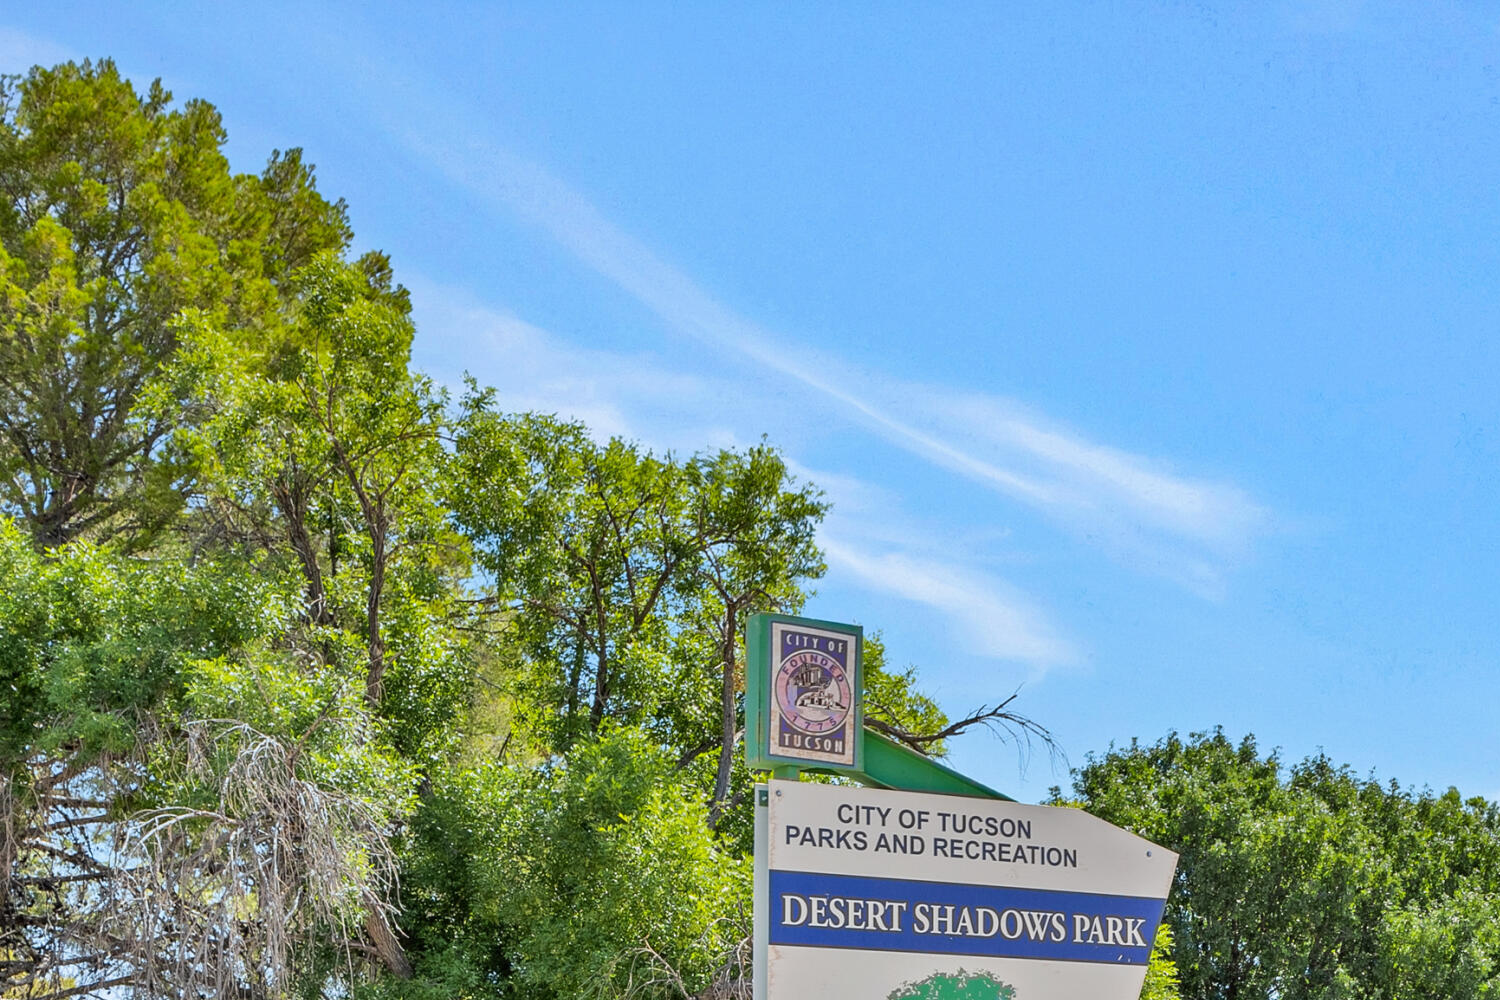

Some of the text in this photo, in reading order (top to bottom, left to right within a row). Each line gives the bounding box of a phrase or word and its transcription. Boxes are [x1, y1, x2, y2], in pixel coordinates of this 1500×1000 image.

[786, 634, 845, 653] CITY OF
[782, 654, 844, 683] FOUNDED
[791, 715, 837, 730] 1775
[783, 733, 843, 753] TUCSON
[837, 804, 1032, 839] CITY OF TUCSON
[785, 825, 1077, 868] PARKS AND RECREATION
[781, 895, 1147, 947] DESERT SHADOWS PARK
